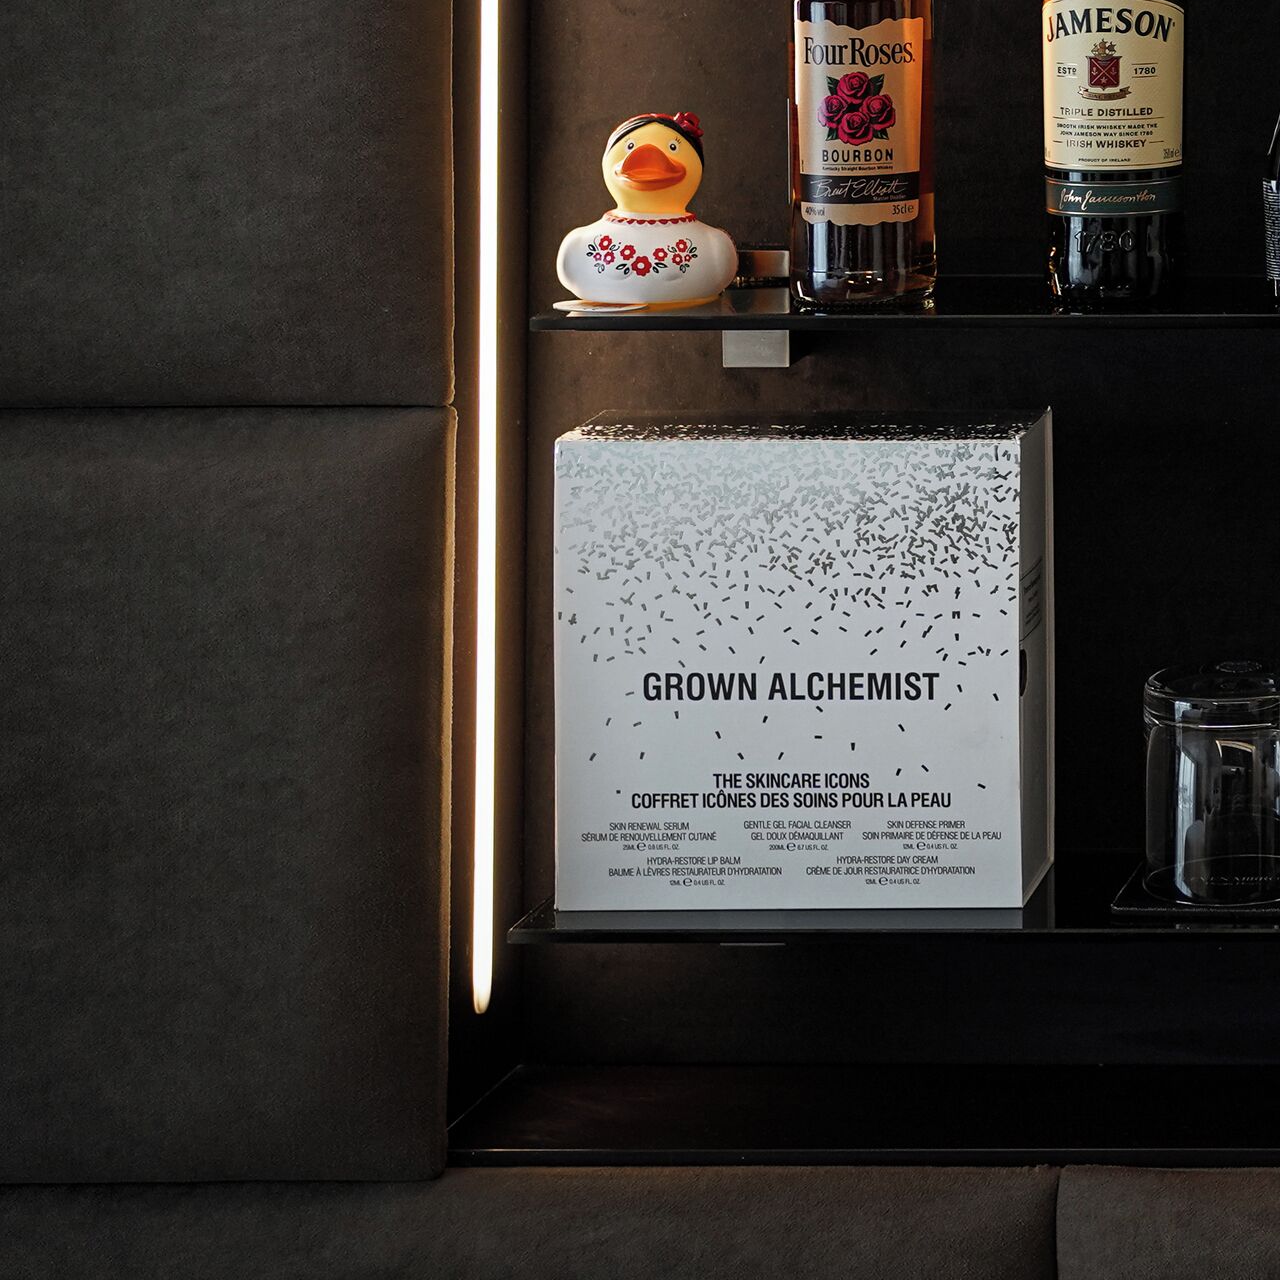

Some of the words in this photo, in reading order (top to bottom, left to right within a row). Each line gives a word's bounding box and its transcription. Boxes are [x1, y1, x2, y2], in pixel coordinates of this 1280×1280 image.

[1047, 8, 1174, 43] JAMESON
[804, 37, 848, 65] Four
[1134, 67, 1156, 75] 1780
[1060, 107, 1093, 117] TRIPLE
[1097, 107, 1153, 117] DISTILLED
[1066, 139, 1093, 148] IRISH
[1095, 139, 1147, 148] WHISKEY
[822, 148, 894, 162] BOURBON
[1059, 188, 1082, 210] John
[643, 672, 758, 701] GROWN
[768, 672, 940, 701] ALCHEMIST
[713, 773, 742, 789] THE
[746, 773, 821, 789] SKINCARE
[824, 773, 870, 789] ICONS
[631, 793, 699, 809] COFFRET
[702, 789, 757, 809] ICÔNES
[760, 793, 790, 809] DES
[793, 793, 838, 809] SOINS
[842, 793, 884, 809] POUR
[887, 793, 908, 809] LA
[911, 793, 952, 809] PEAU
[609, 822, 627, 831] SKIN
[627, 822, 661, 831] RENEWAL
[664, 822, 690, 831] SERUM
[743, 821, 771, 829] GENTLE
[772, 821, 786, 829] GEL
[788, 821, 813, 829] FACIAL
[814, 821, 851, 829] CLEANSER
[887, 820, 905, 829] SKIN
[905, 820, 937, 829] DEFENSE
[938, 820, 966, 829] PRIMER
[581, 832, 608, 842] SÉRUM
[609, 833, 619, 841] DE
[620, 833, 687, 841] RENOUVELLEMENT
[688, 831, 717, 841] CUTANÉ
[750, 832, 765, 841] GEL
[766, 832, 787, 841] DOUX
[789, 830, 844, 841] DÉMAQUILLANT
[862, 832, 880, 840] SOIN
[881, 832, 914, 840] PRIMAIRE
[915, 832, 926, 840] DE
[927, 830, 959, 840] DÉFENSE
[960, 832, 970, 840] DE
[971, 832, 981, 840] LA
[982, 832, 1001, 840] PEAU
[647, 856, 706, 865] HYDRA-RESTORE
[707, 856, 719, 865] LIP
[720, 856, 741, 865] BALM
[836, 856, 896, 865] HYDRA-RESTORE
[896, 856, 910, 865] DAY
[912, 856, 939, 864] CREAM
[608, 868, 635, 877] BAUME
[671, 868, 727, 876] RESTAURATEUR
[727, 867, 782, 876] D'HYDRATATION
[832, 867, 843, 875] DE
[844, 867, 863, 875] JOUR
[864, 867, 920, 875] RESTAURATRICE
[921, 867, 975, 875] D'HYDRATATION
